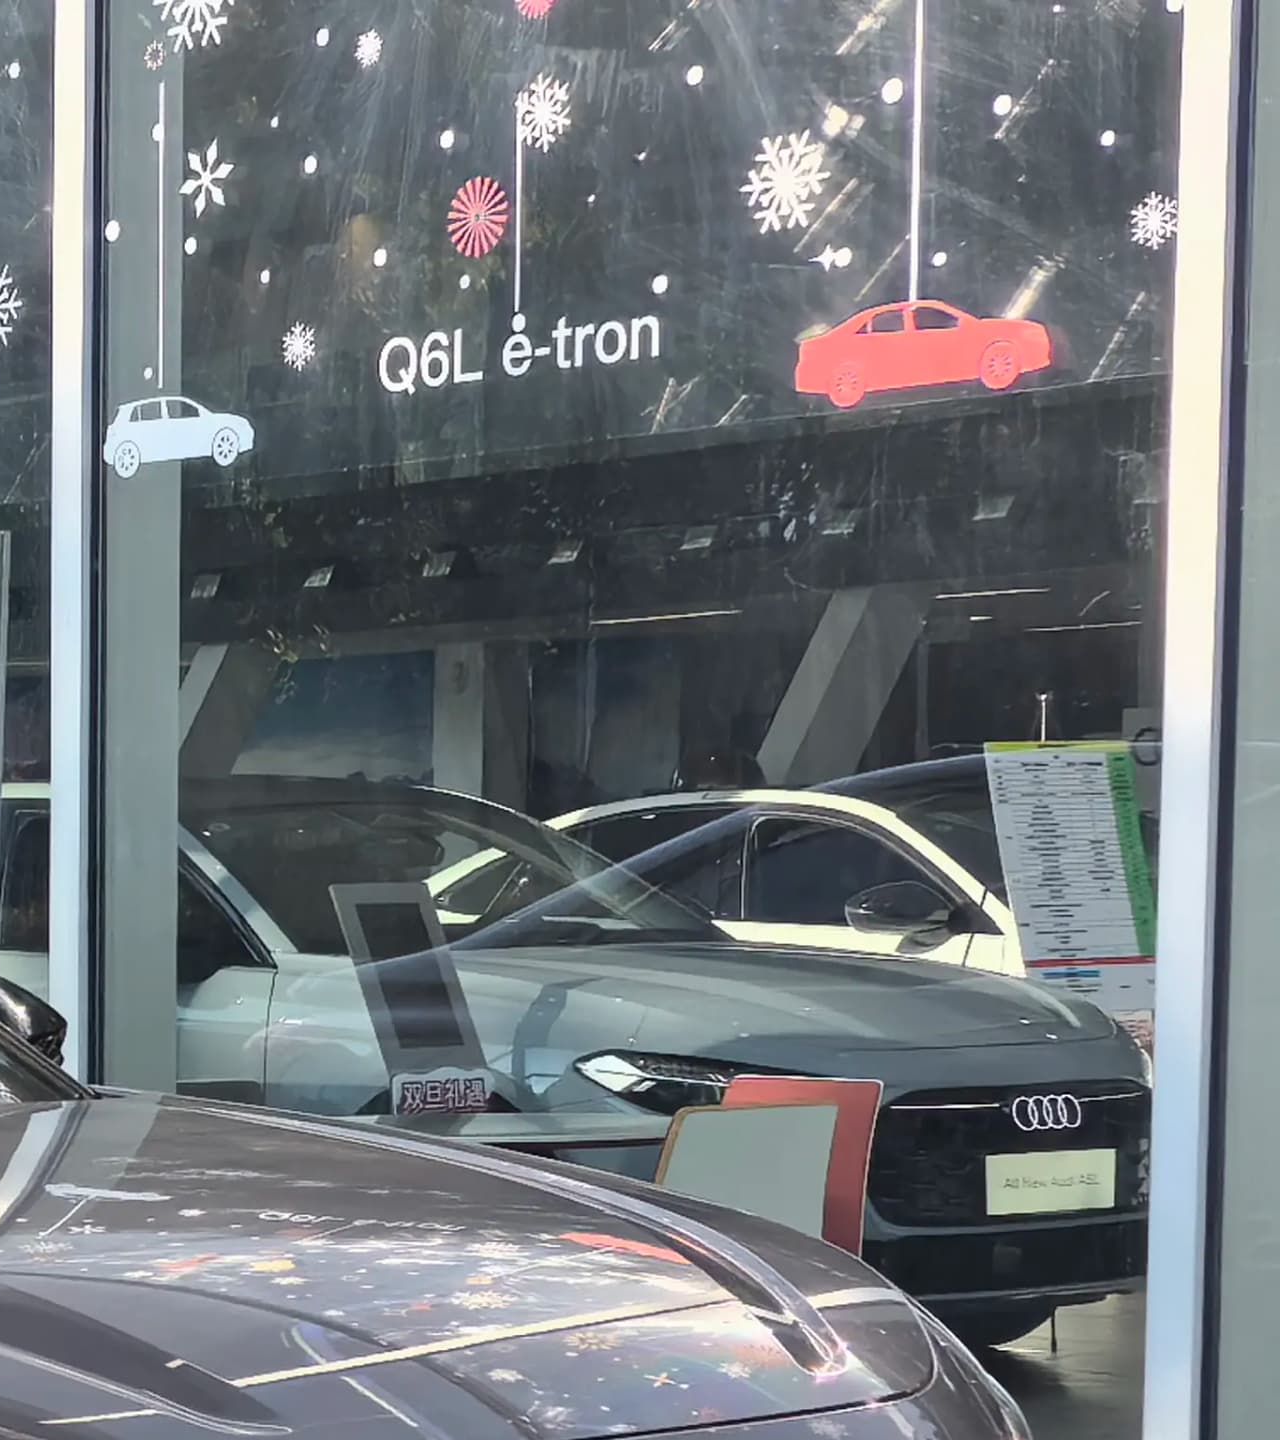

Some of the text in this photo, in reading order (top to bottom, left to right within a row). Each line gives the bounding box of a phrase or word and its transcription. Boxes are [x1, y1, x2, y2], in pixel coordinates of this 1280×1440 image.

[378, 315, 660, 395] Q6L e-tron
[402, 1079, 487, 1110] 双旦礼遇
